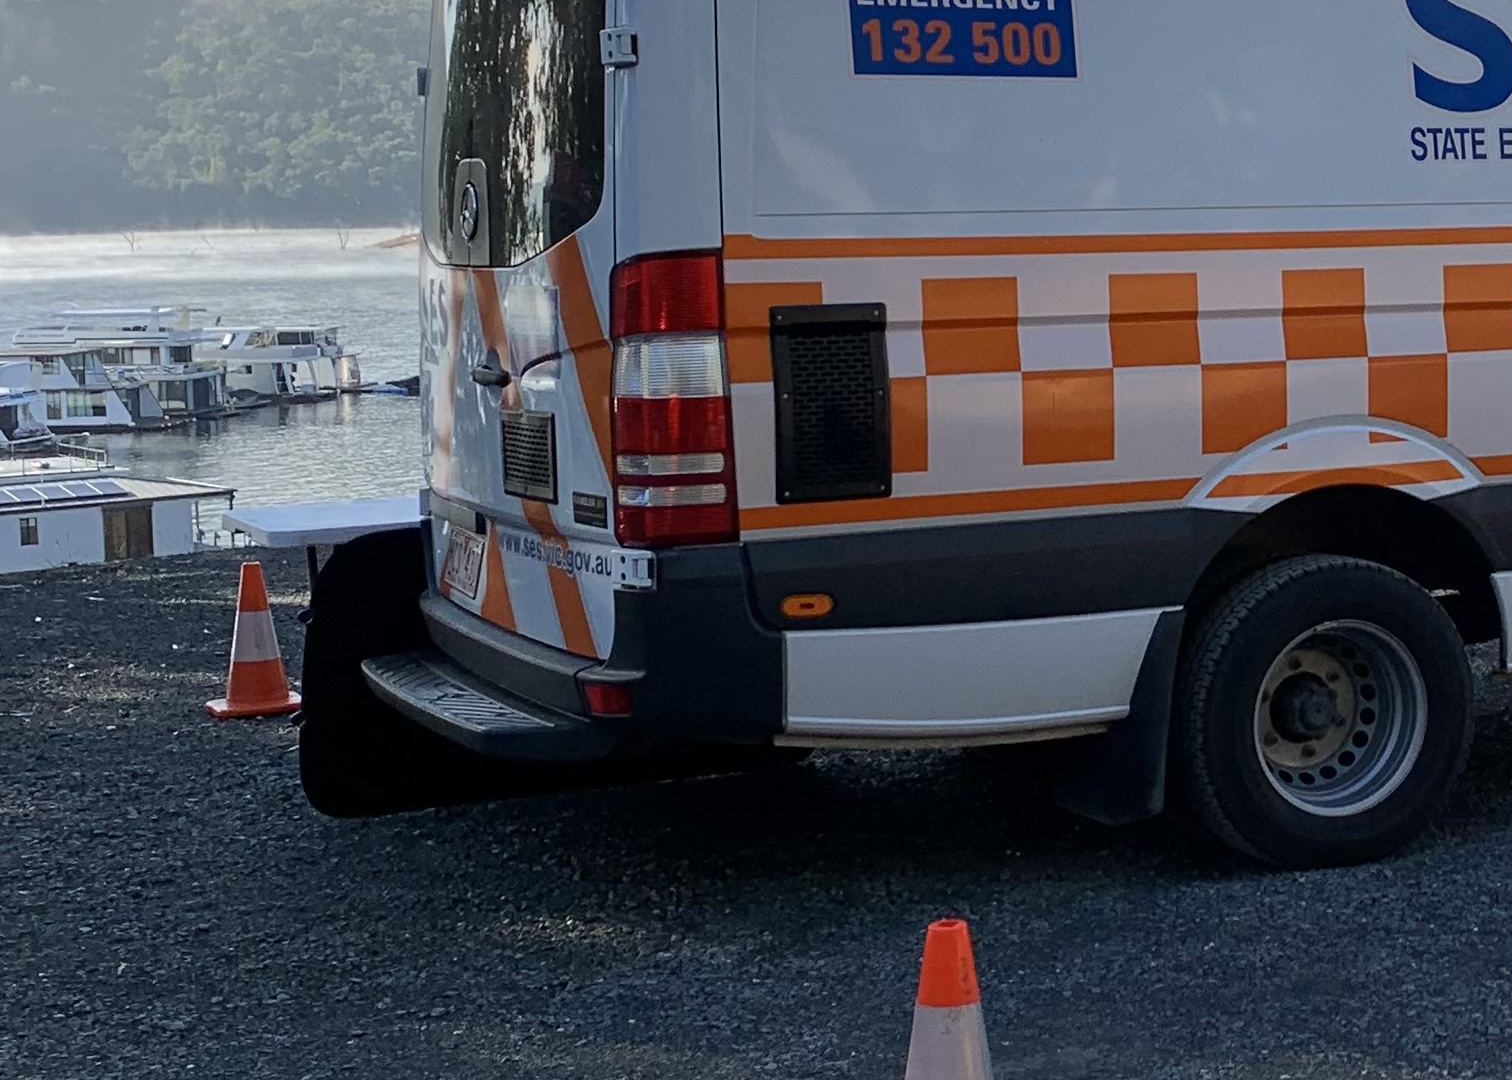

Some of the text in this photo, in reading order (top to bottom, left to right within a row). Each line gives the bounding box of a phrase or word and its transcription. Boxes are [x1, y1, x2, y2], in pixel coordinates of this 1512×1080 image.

[861, 18, 1062, 66] 132 500
[1410, 126, 1487, 161] STATE
